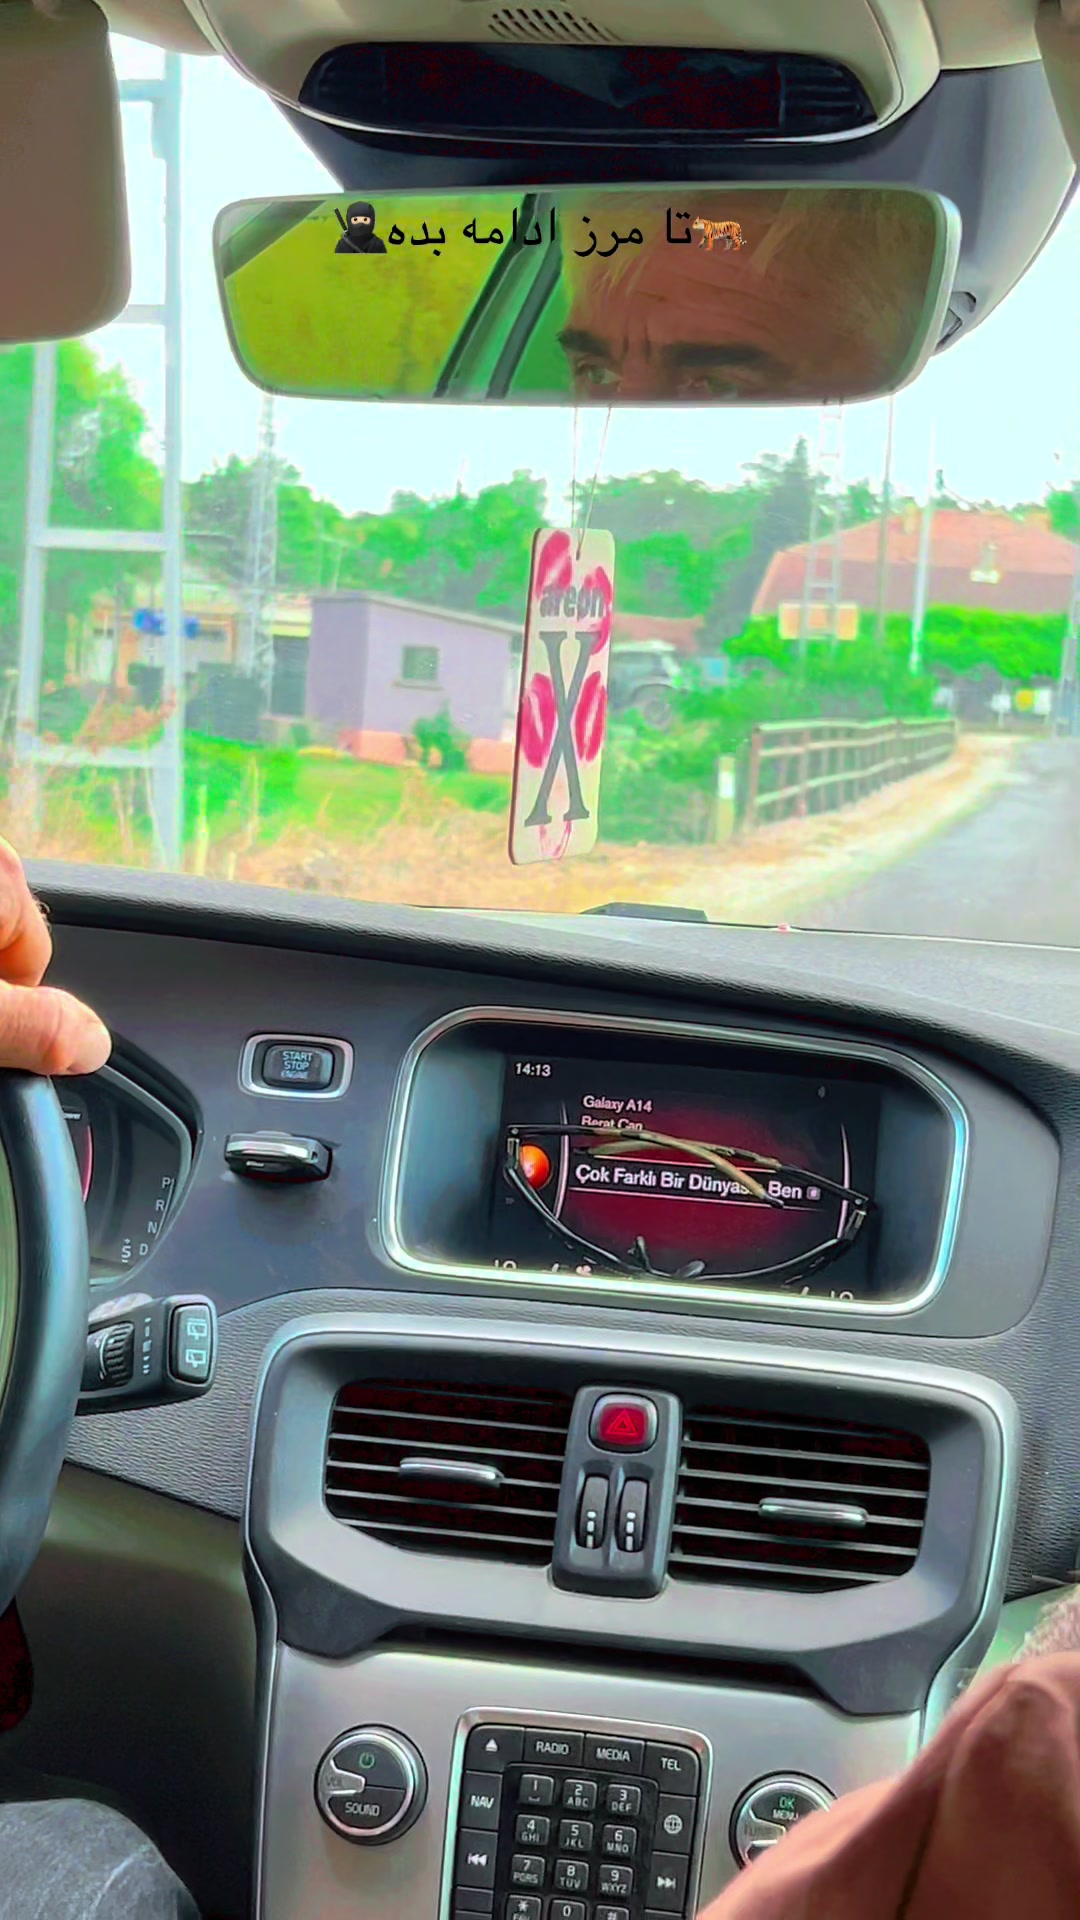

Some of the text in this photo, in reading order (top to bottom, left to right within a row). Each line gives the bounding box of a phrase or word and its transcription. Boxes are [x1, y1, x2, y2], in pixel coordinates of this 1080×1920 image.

[525, 631, 601, 827] X
[282, 1050, 313, 1061] START
[284, 1061, 310, 1070] STOP
[515, 1062, 551, 1077] 14:13
[582, 1095, 653, 1113] Galaxy A14
[617, 1118, 643, 1131] Can
[162, 1176, 171, 1189] P
[575, 1164, 609, 1185] Çok
[613, 1167, 657, 1186] Farklı
[660, 1172, 685, 1188] Bir
[768, 1180, 801, 1199] Ben
[155, 1199, 165, 1211] R
[147, 1220, 158, 1234] N
[139, 1243, 149, 1256] D
[536, 1741, 569, 1755] RADIO
[596, 1748, 631, 1762] MEDIA
[660, 1757, 682, 1771] TEL
[532, 1780, 538, 1791] 1
[574, 1784, 583, 1796] 2
[619, 1789, 628, 1801] 3
[470, 1795, 494, 1809] NAV
[567, 1797, 589, 1808] ABC
[611, 1802, 632, 1812] DEF
[779, 1797, 795, 1809] OK
[345, 1802, 380, 1817] SOUND
[773, 1809, 799, 1821] MENU
[526, 1820, 535, 1831] 4
[570, 1825, 580, 1836] 5
[521, 1832, 540, 1843] GHI
[614, 1830, 623, 1842] 6
[564, 1838, 585, 1849] JKL
[606, 1842, 630, 1854] MNO
[522, 1859, 531, 1871] 7
[567, 1865, 576, 1877] 8
[611, 1870, 620, 1882] 9
[560, 1877, 581, 1890] TUV
[562, 1904, 573, 1918] 0
